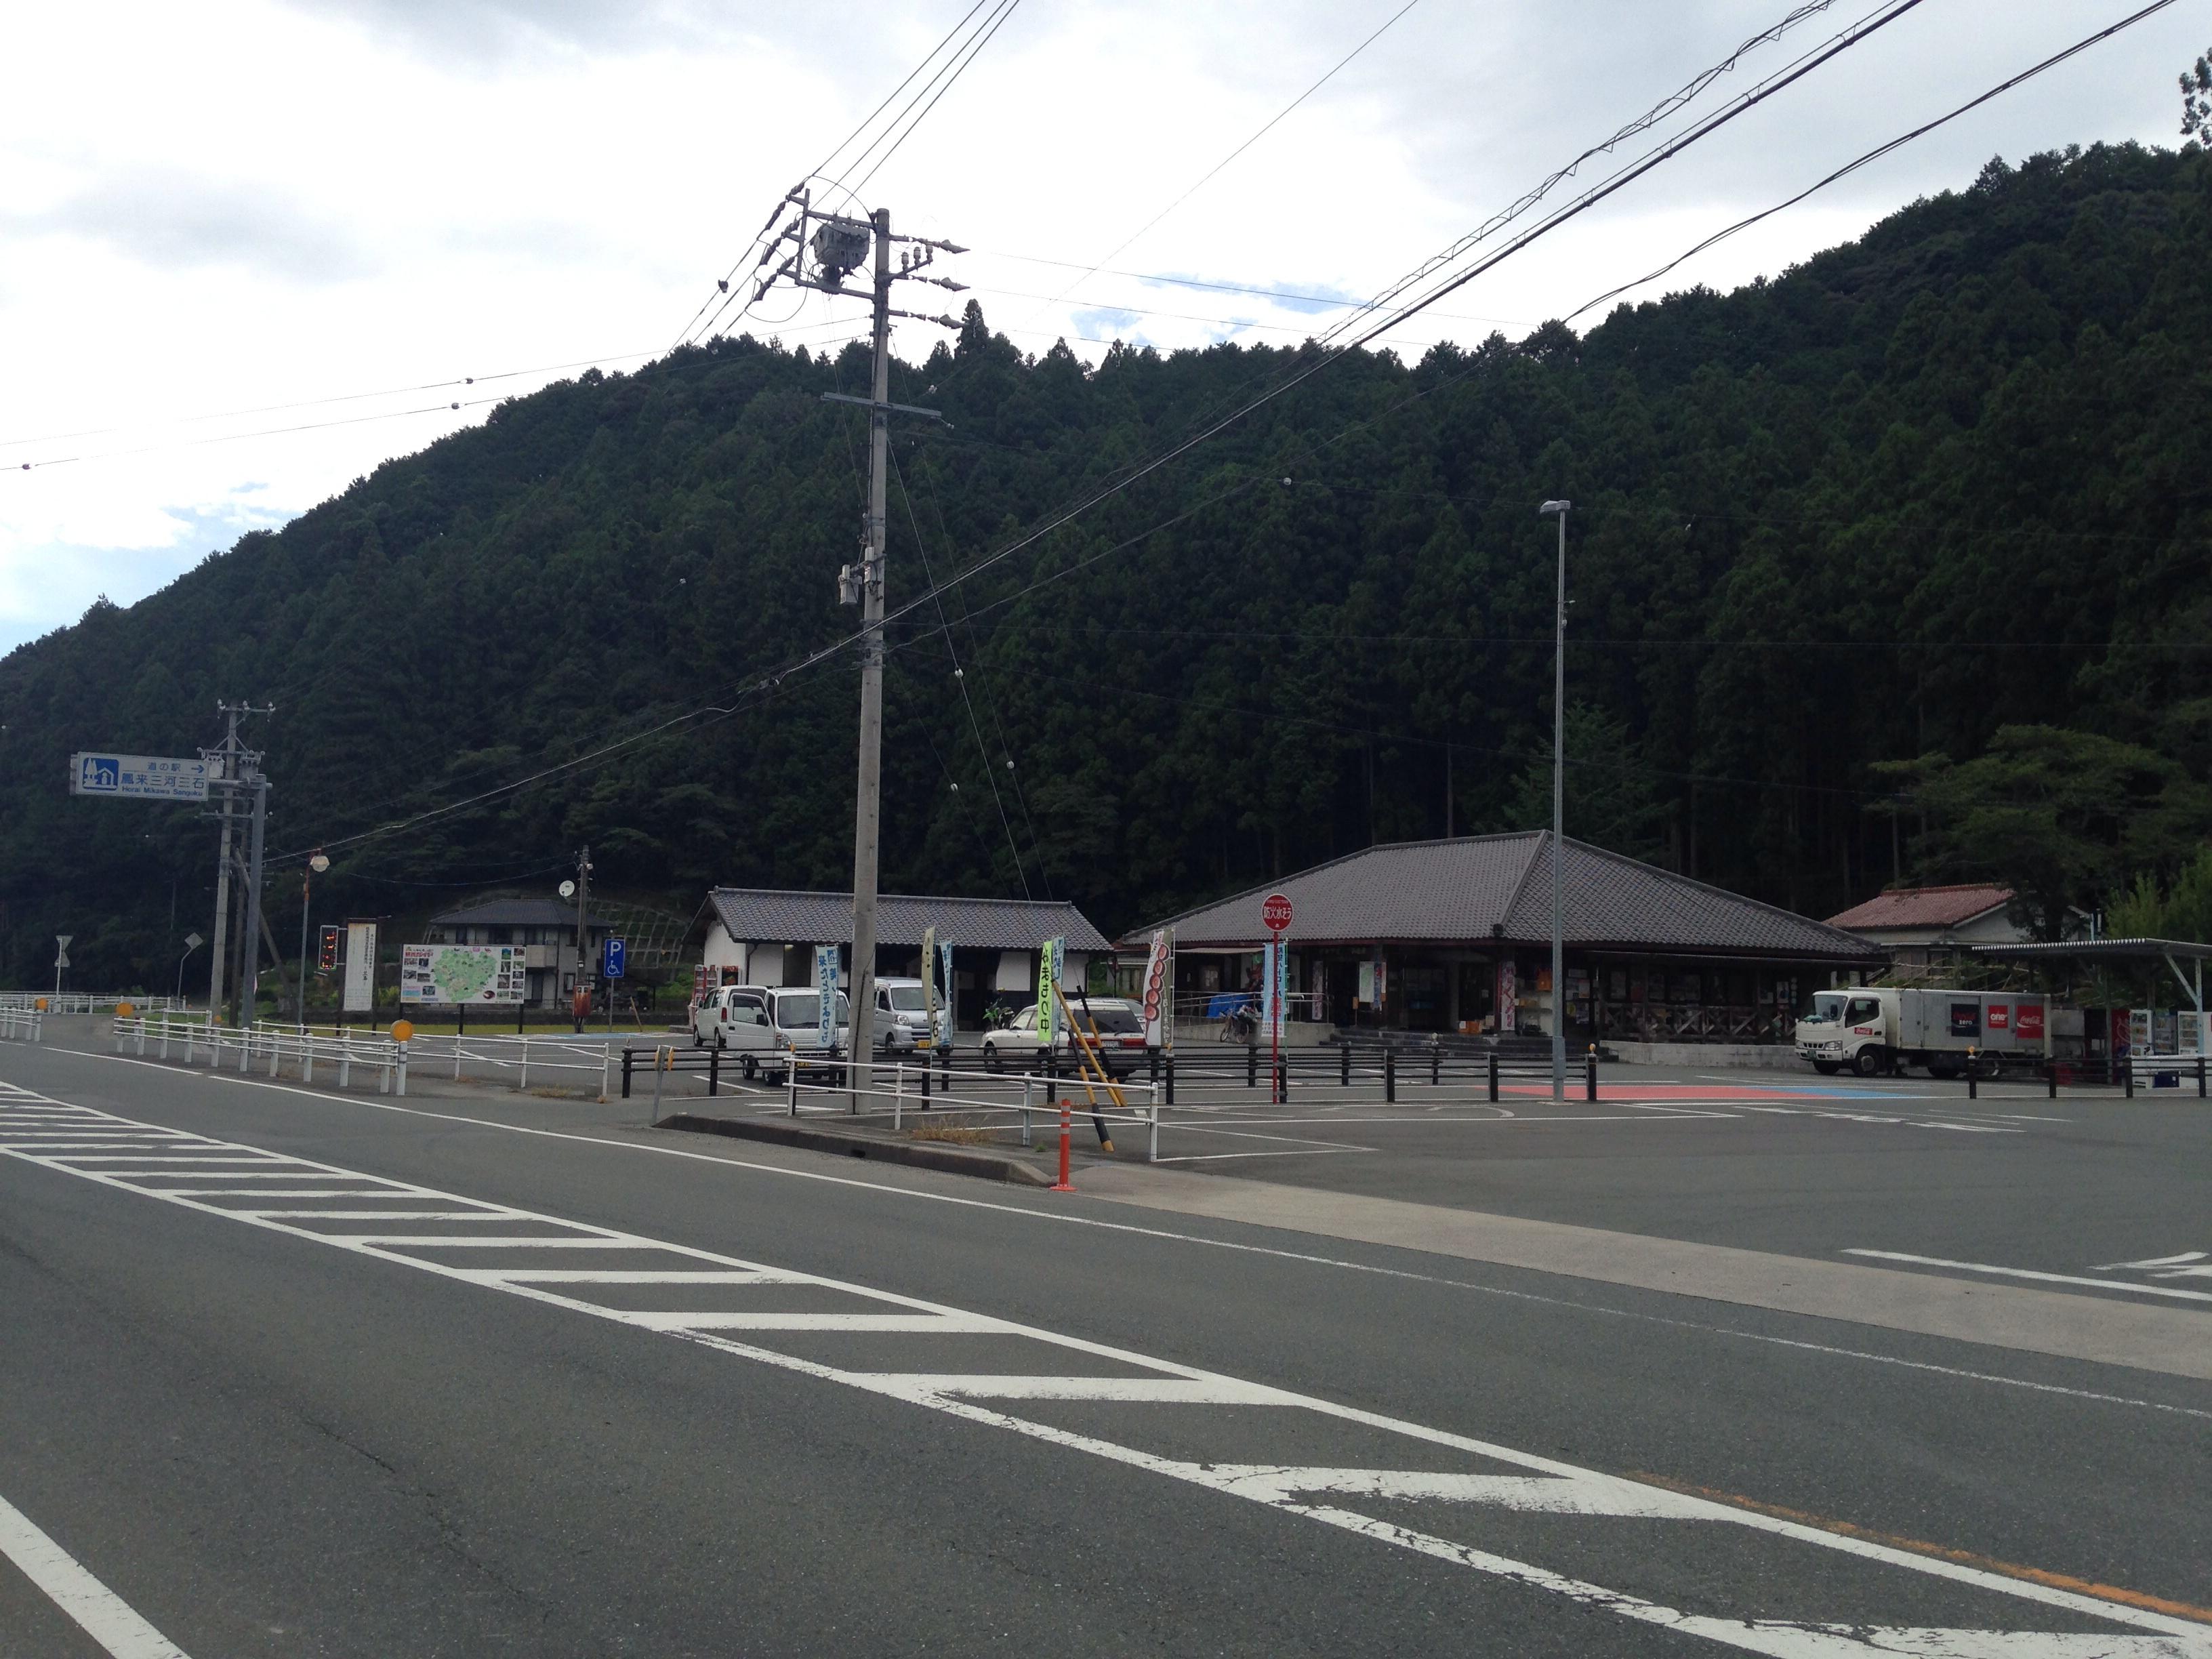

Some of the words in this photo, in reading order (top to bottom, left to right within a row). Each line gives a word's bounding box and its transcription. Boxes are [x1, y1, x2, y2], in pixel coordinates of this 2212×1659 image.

[147, 762, 181, 772] 道の駅
[173, 789, 203, 797] Sangoku
[1264, 906, 1292, 920] 防火水そう
[610, 941, 621, 956] P
